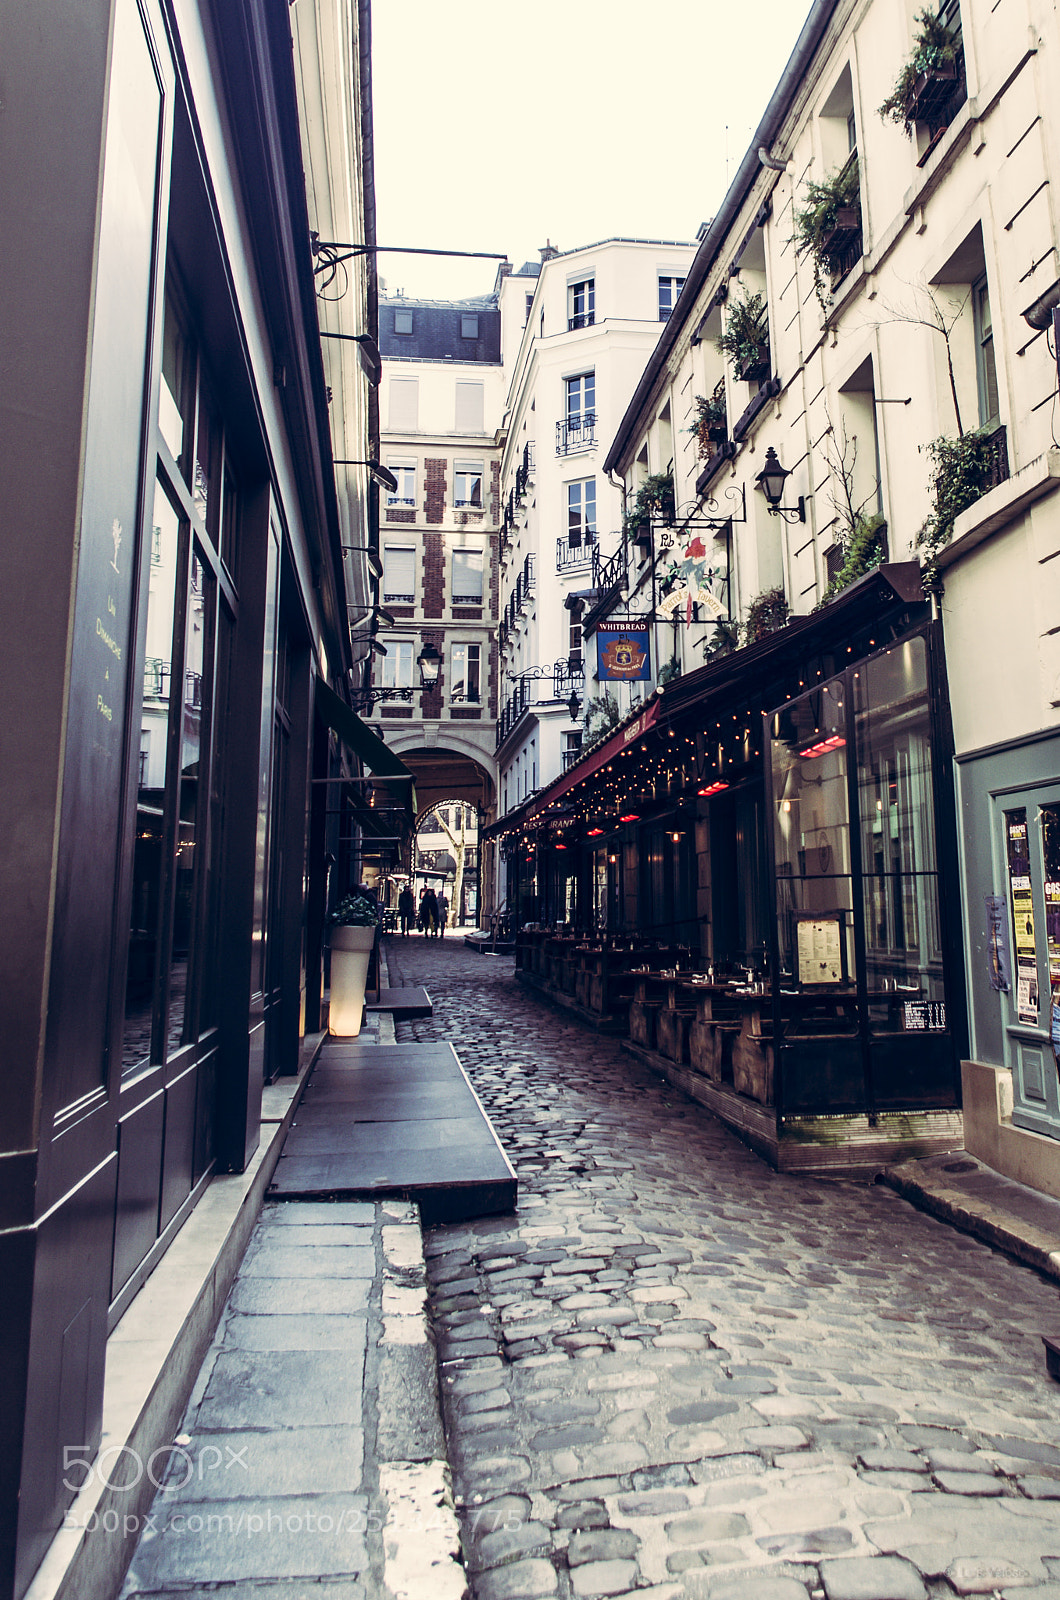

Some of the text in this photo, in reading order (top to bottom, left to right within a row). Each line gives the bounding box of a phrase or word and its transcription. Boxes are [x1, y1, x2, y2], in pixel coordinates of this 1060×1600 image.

[660, 533, 675, 547] Pub
[661, 589, 721, 613] Parrot's Tavern
[599, 623, 646, 631] WHITBREAD
